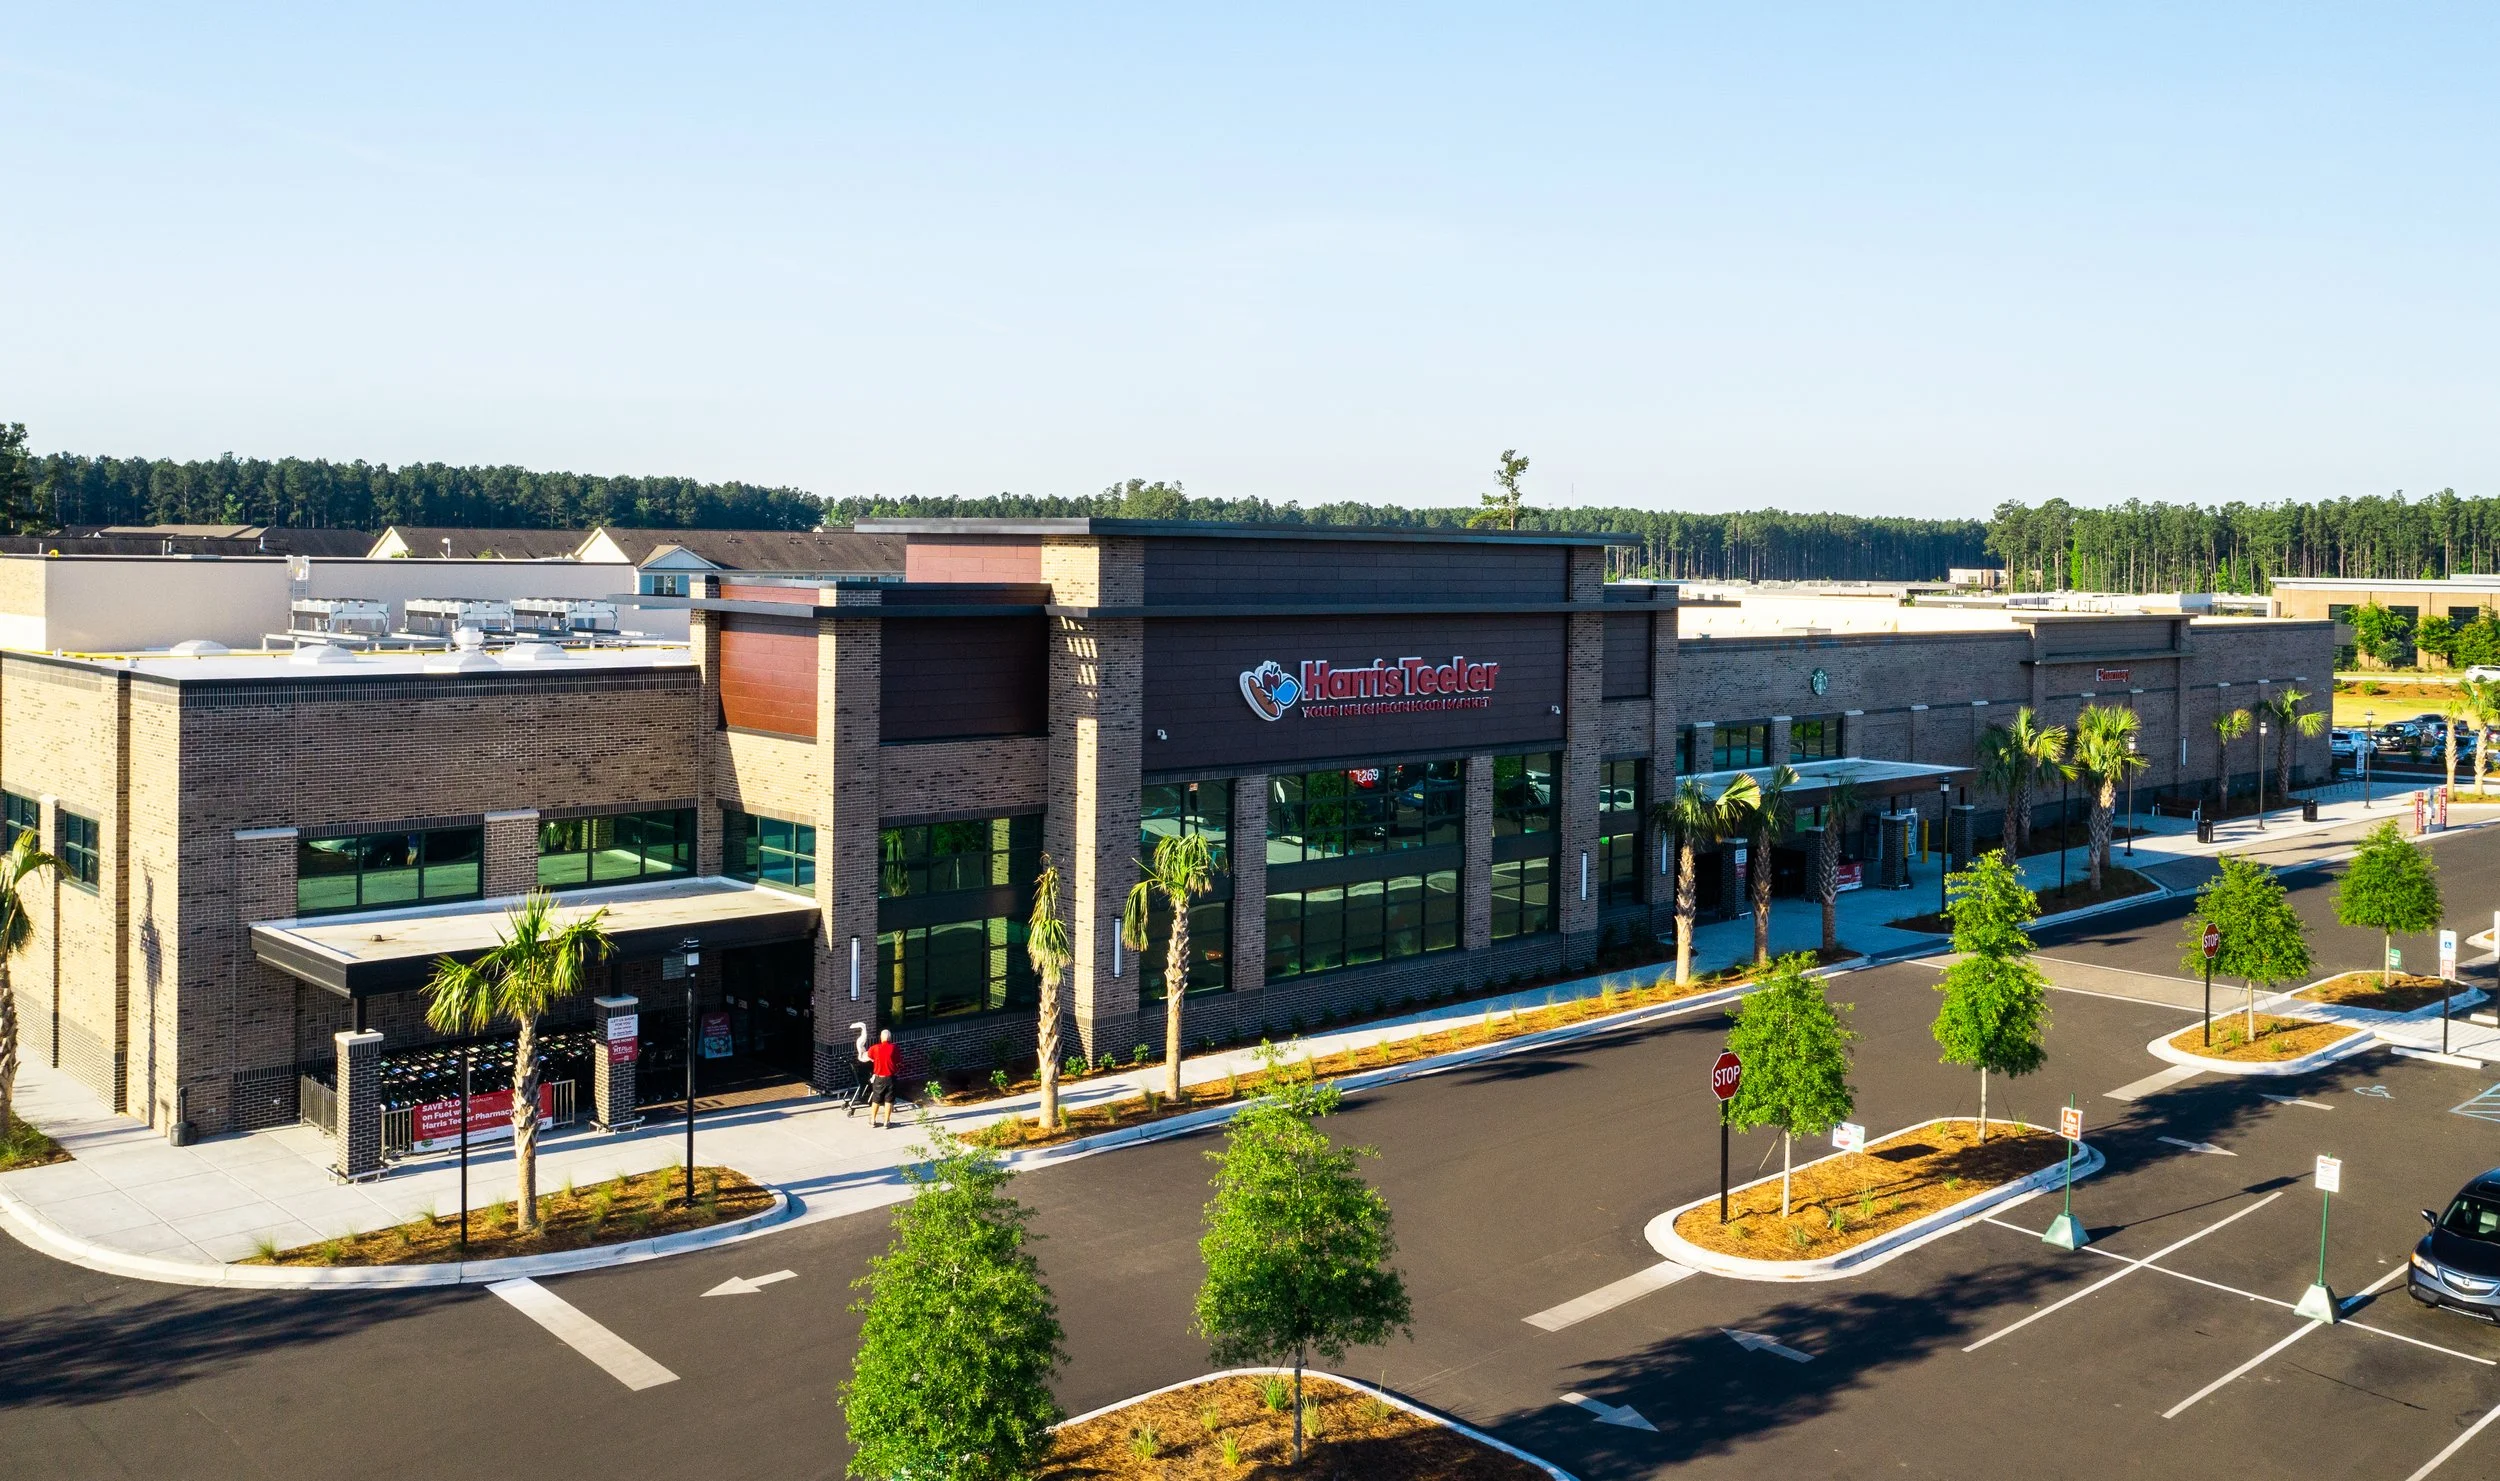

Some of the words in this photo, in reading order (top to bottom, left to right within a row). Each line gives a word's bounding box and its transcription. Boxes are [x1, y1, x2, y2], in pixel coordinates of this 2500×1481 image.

[1301, 658, 1402, 701] Harris
[1398, 655, 1498, 696] Teeter
[1301, 705, 1339, 718] YOUR
[1357, 768, 1379, 782] 1269
[2204, 933, 2219, 948] STOP
[1714, 1065, 1740, 1087] STOP
[422, 1103, 443, 1112] SAVE
[444, 1100, 463, 1108] $1.0
[434, 1110, 452, 1119] Fuel
[453, 1107, 471, 1116] wih
[422, 1120, 447, 1130] Harris
[448, 1115, 474, 1125] Teeer
[475, 1109, 514, 1120] Pharmacy
